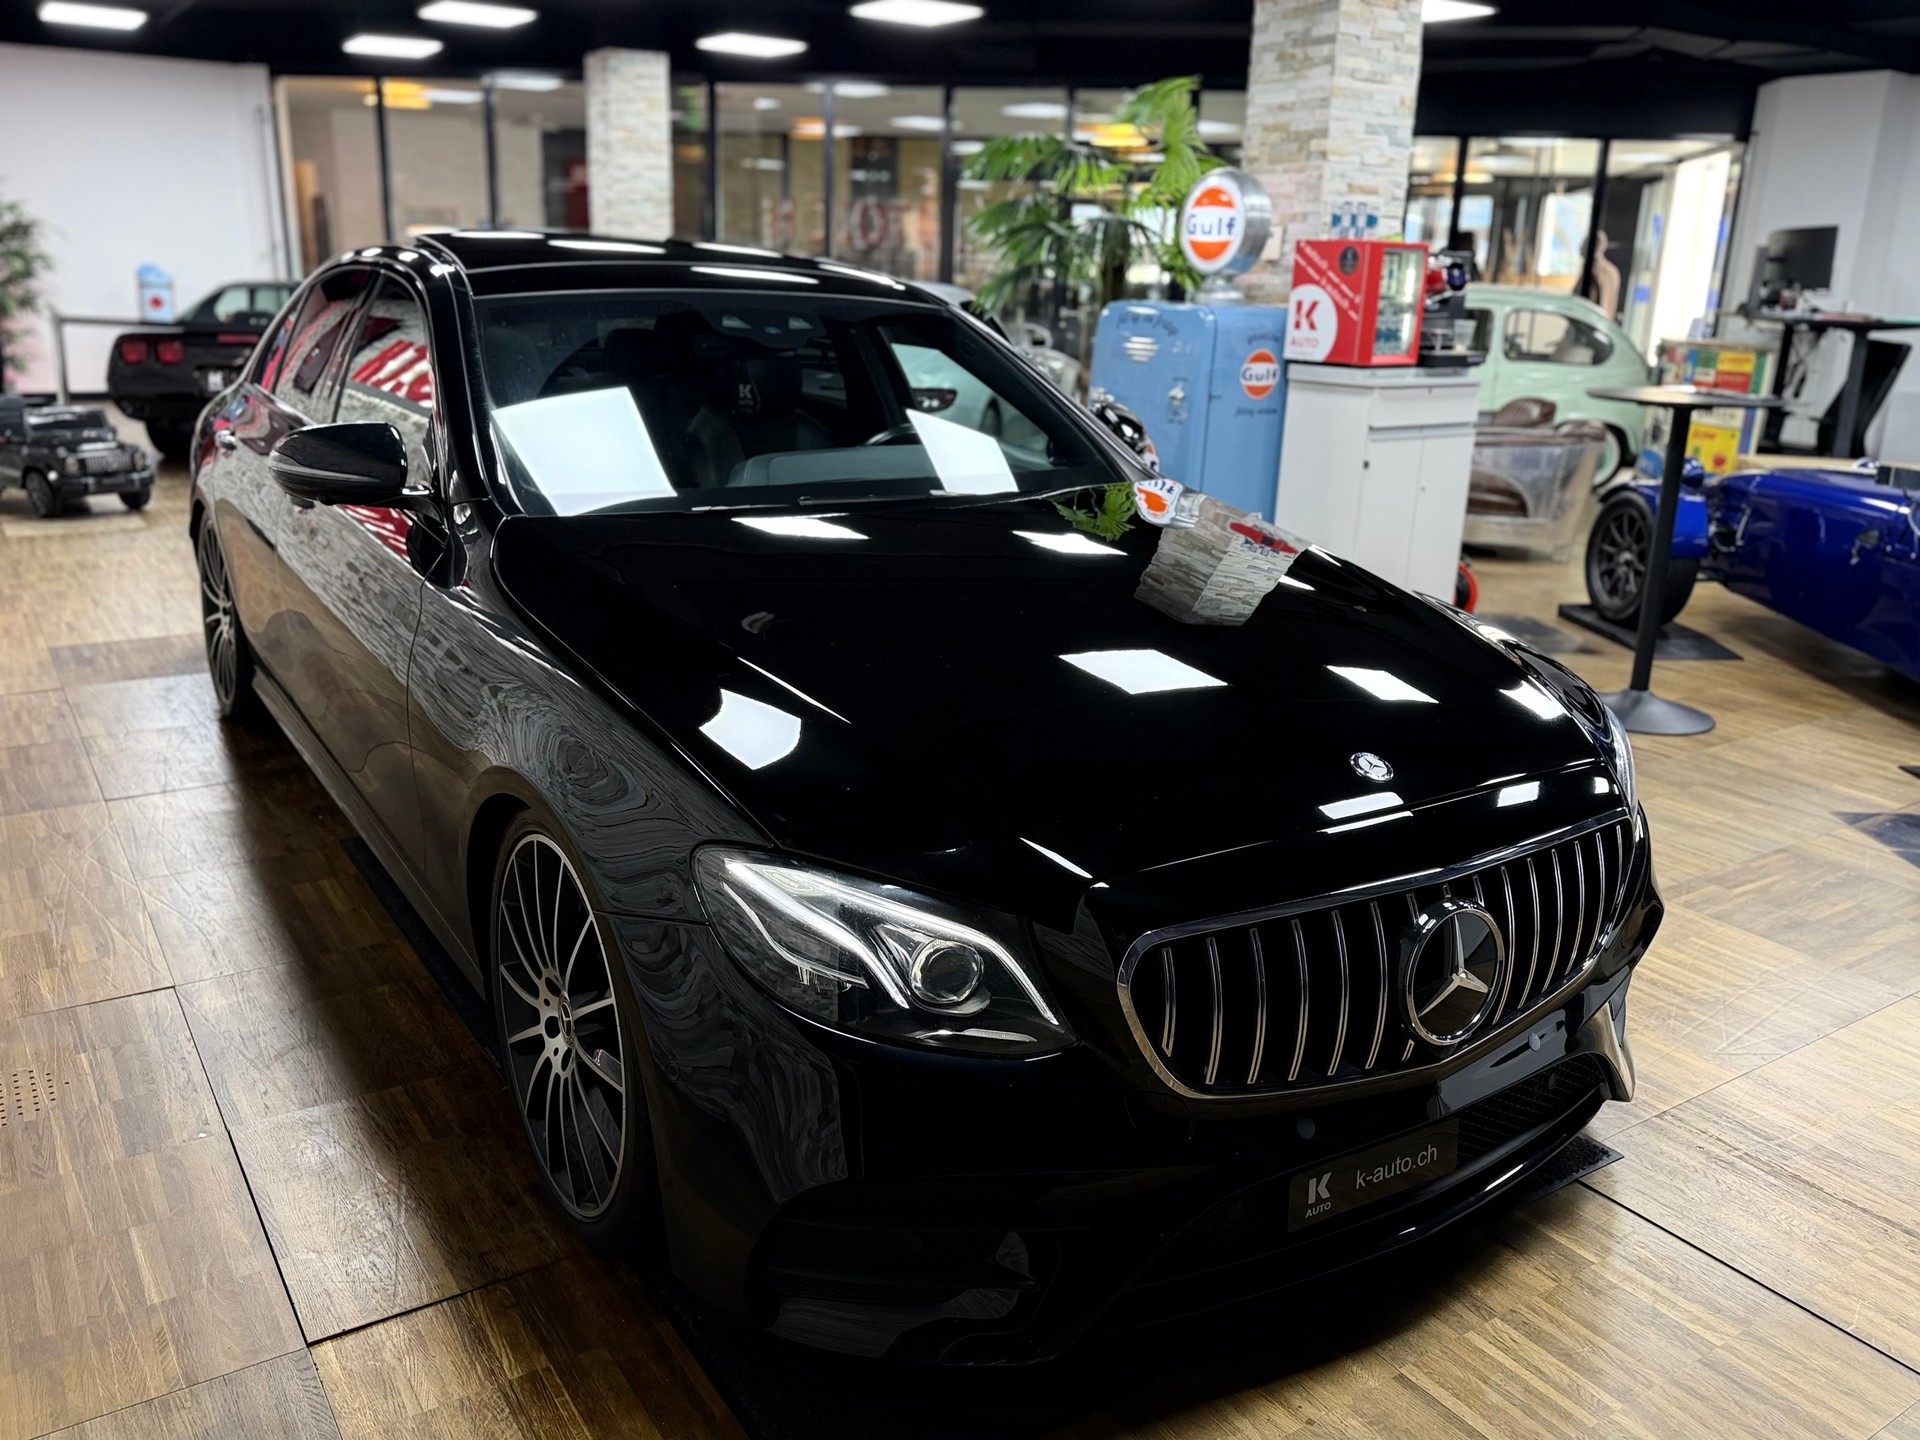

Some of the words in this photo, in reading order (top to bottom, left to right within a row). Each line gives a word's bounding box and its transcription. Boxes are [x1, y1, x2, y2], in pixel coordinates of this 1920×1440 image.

[1186, 214, 1236, 236] Gulf
[1294, 299, 1320, 331] K
[1290, 337, 1319, 348] AUTO
[1242, 367, 1278, 382] Gulf
[739, 384, 752, 398] K
[1308, 1172, 1332, 1204] K
[1355, 1144, 1437, 1189] k-auto.ch
[1305, 1202, 1332, 1218] AUTO
